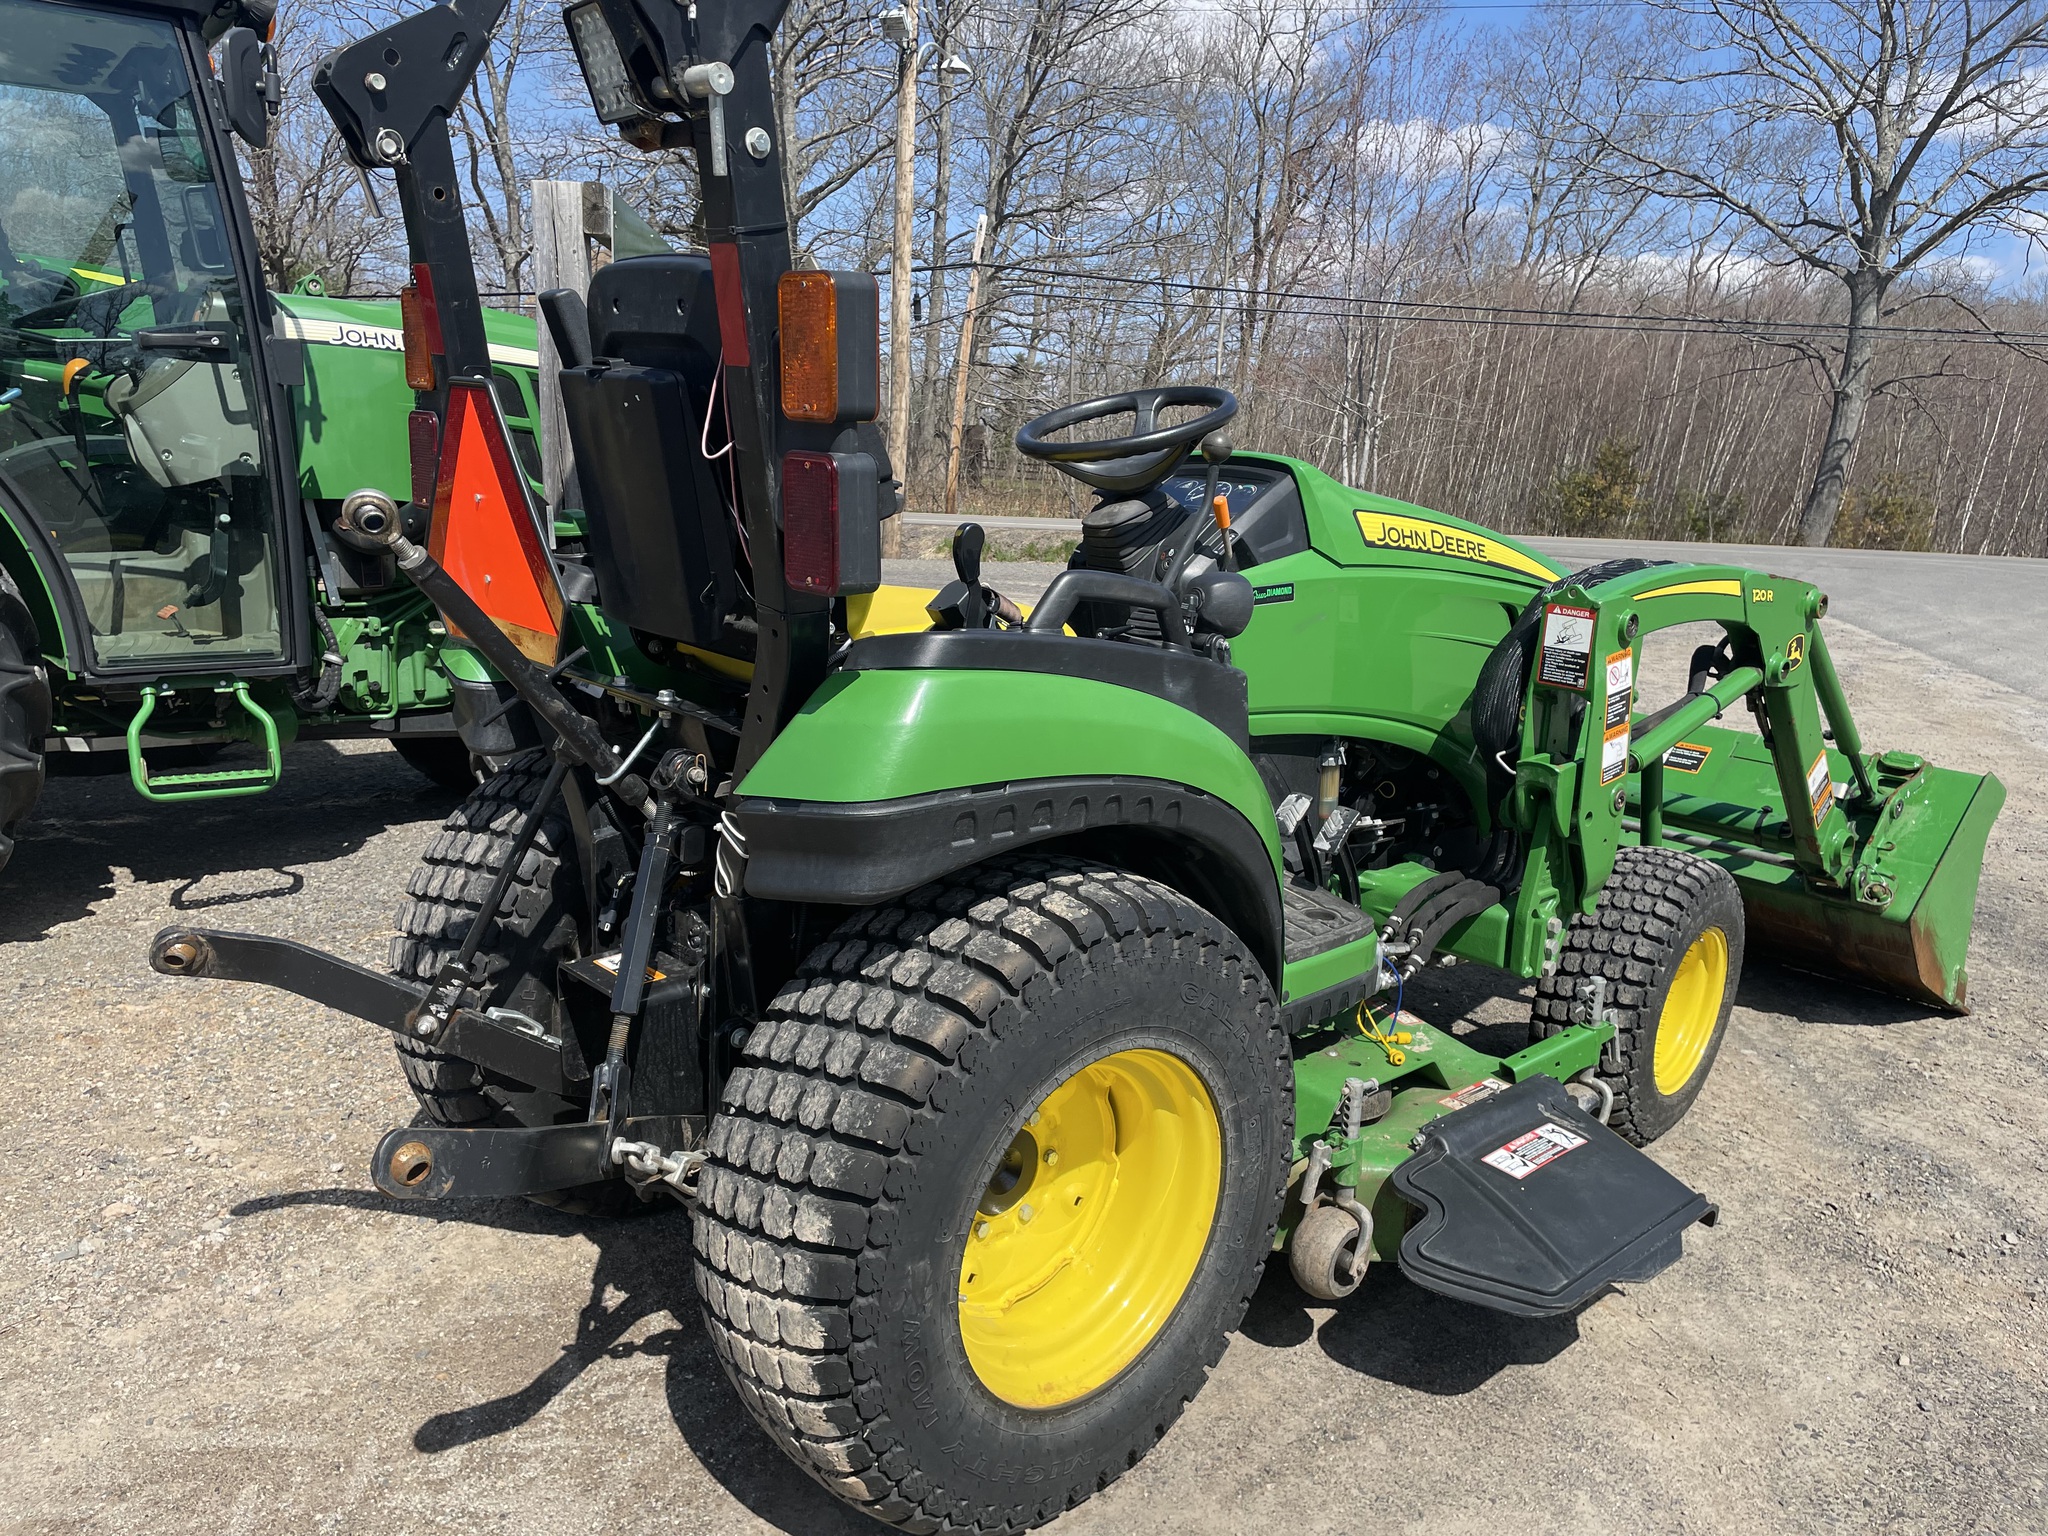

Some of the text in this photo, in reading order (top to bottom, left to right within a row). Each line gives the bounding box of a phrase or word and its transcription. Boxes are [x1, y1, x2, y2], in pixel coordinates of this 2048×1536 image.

[331, 325, 397, 348] JOHN
[1377, 522, 1487, 559] JOHN DEERE
[1266, 586, 1292, 597] DIAMOND
[1562, 607, 1590, 618] DANGER
[1180, 981, 1271, 1094] GALAXY
[941, 1440, 1094, 1486] MIGHTY
